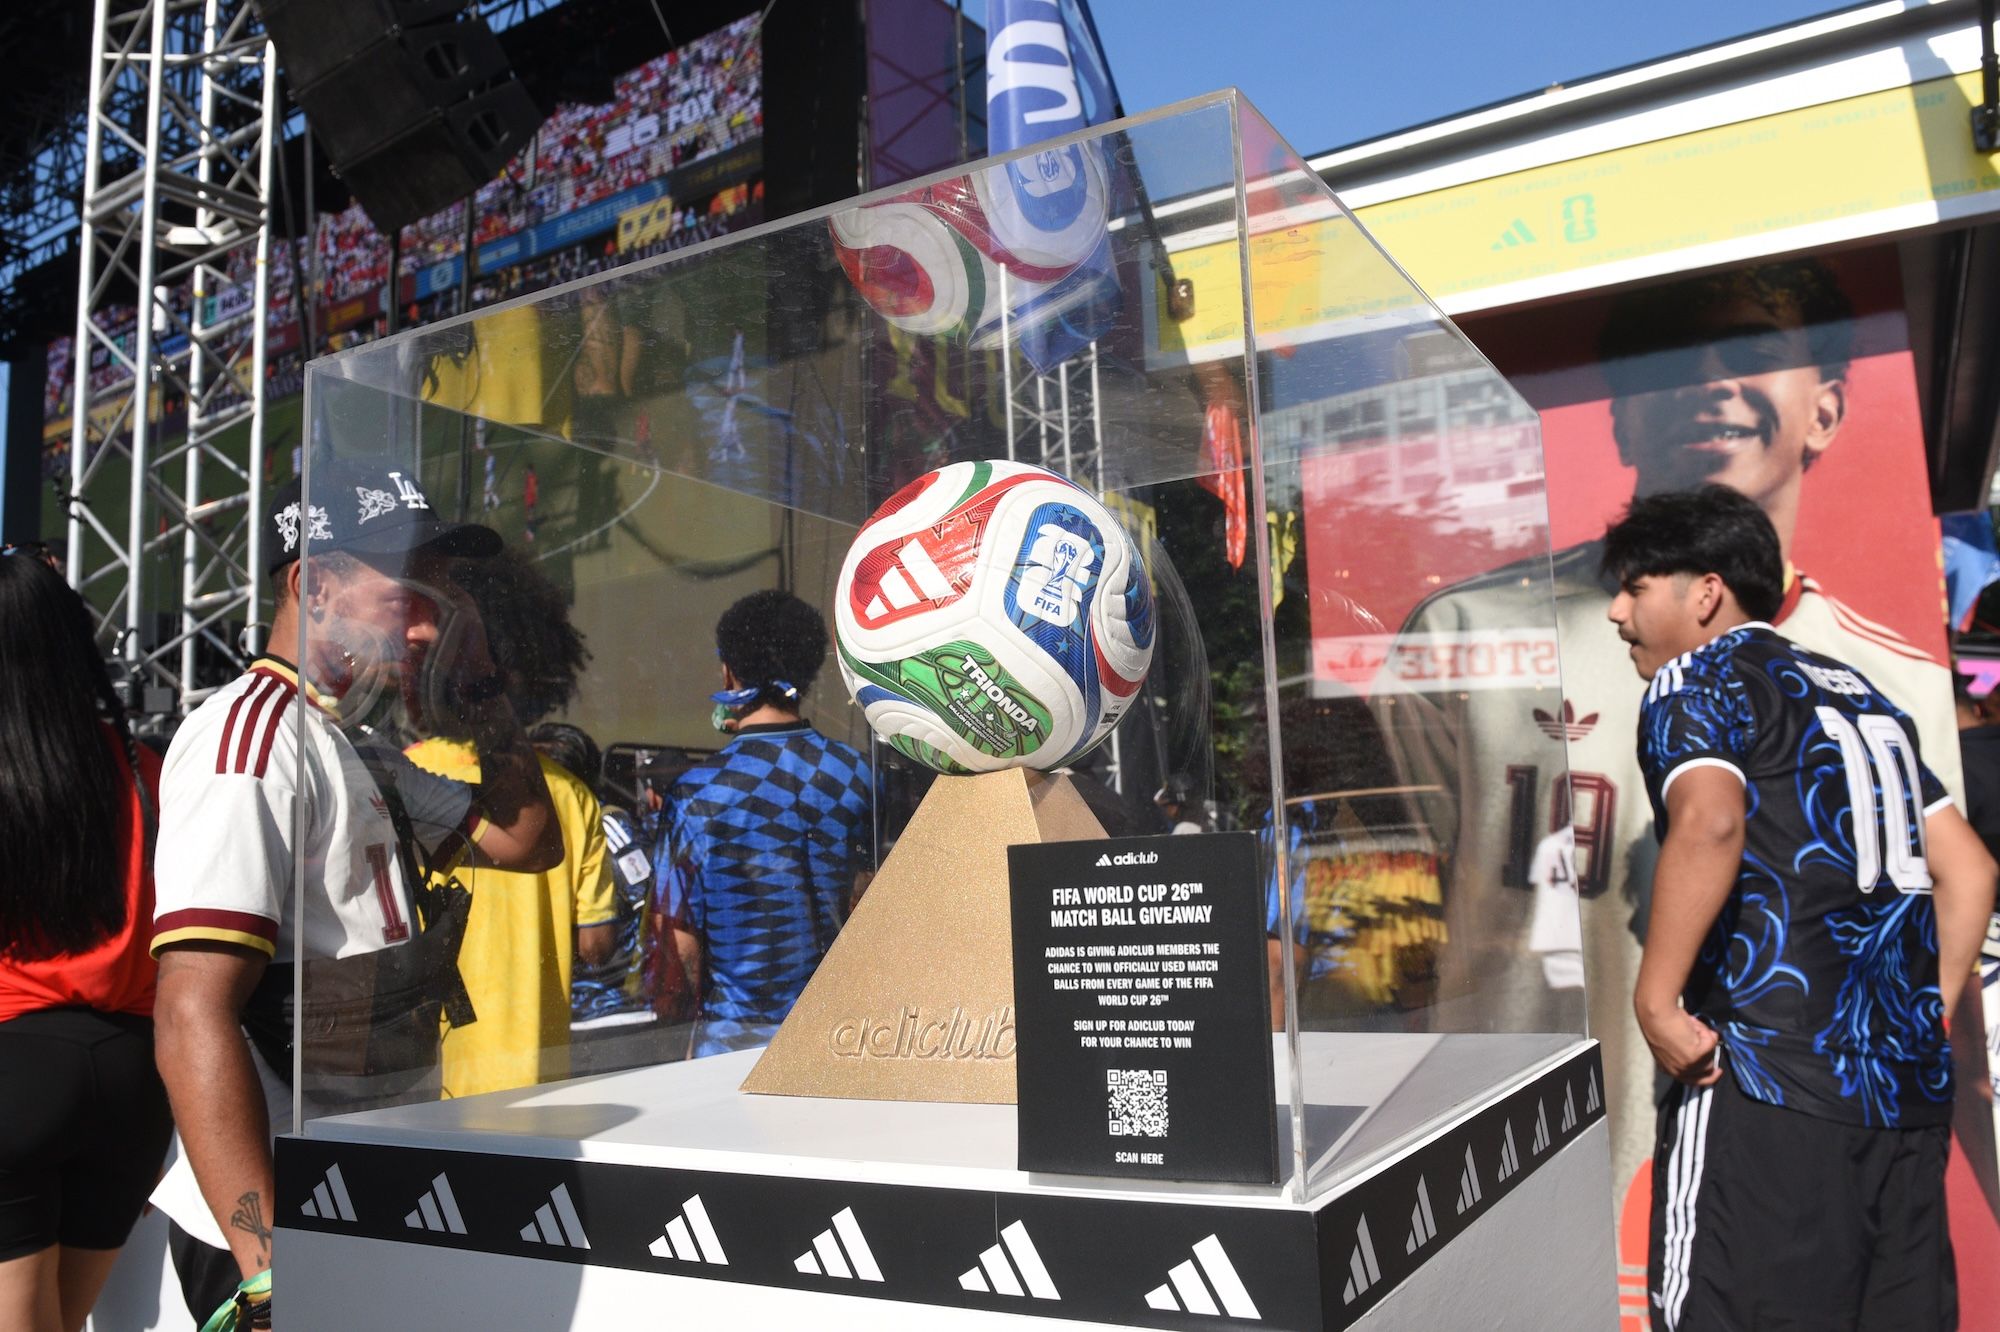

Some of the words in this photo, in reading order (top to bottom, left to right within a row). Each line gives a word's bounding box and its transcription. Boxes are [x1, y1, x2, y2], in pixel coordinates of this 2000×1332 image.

[667, 90, 716, 133] FOX
[388, 472, 429, 509] LA
[1034, 596, 1061, 617] FIFA
[962, 654, 1038, 732] TRIONDA
[947, 704, 967, 722] BALLON
[965, 720, 972, 728] DE
[1815, 705, 1934, 895] 10
[1113, 851, 1159, 866] adiclub
[1052, 887, 1081, 905] FIFA
[1084, 885, 1134, 904] WORLD
[1138, 884, 1167, 902] CUP
[1171, 882, 1203, 901] 26™
[1051, 909, 1097, 927] MATCH
[1101, 908, 1136, 926] BALL
[1139, 905, 1212, 925] GIVEAWAY
[1045, 947, 1075, 958] ADIDAS
[1077, 947, 1085, 957] IS
[1087, 946, 1116, 957] GIVING
[1117, 945, 1154, 956] ADICLUB
[1156, 944, 1201, 956] MEMBERS
[1202, 943, 1220, 955] THE
[1048, 963, 1081, 974] CHANCE
[1082, 962, 1093, 973] TO
[1094, 962, 1111, 973] WIN
[1113, 961, 1160, 973] OFFICIALLY
[1162, 961, 1185, 972] USED
[1187, 960, 1218, 972] MATCH
[1054, 979, 1079, 990] BALLS
[1081, 978, 1105, 990] FROM
[1107, 978, 1133, 989] EVERY
[1135, 978, 1160, 989] GAME
[1162, 978, 1174, 989] OF
[1175, 977, 1193, 988] THE
[1194, 977, 1213, 988] FIFA
[1098, 994, 1128, 1006] WORLD
[1130, 994, 1148, 1006] CUP
[1150, 994, 1169, 1006] 26™
[829, 1006, 1017, 1059] adiclub
[1074, 1020, 1094, 1031] SIGN
[1095, 1020, 1107, 1031] UP
[1109, 1020, 1126, 1031] FOR
[1128, 1020, 1165, 1031] ADICLUB
[1167, 1020, 1195, 1031] TODAY
[1081, 1036, 1097, 1048] FOR
[1099, 1036, 1122, 1048] YOUR
[1124, 1036, 1159, 1048] CHANCE
[1160, 1037, 1172, 1048] TO
[1173, 1037, 1192, 1049] WIN
[1115, 1151, 1139, 1164] SCAN
[1141, 1152, 1164, 1165] HERE
